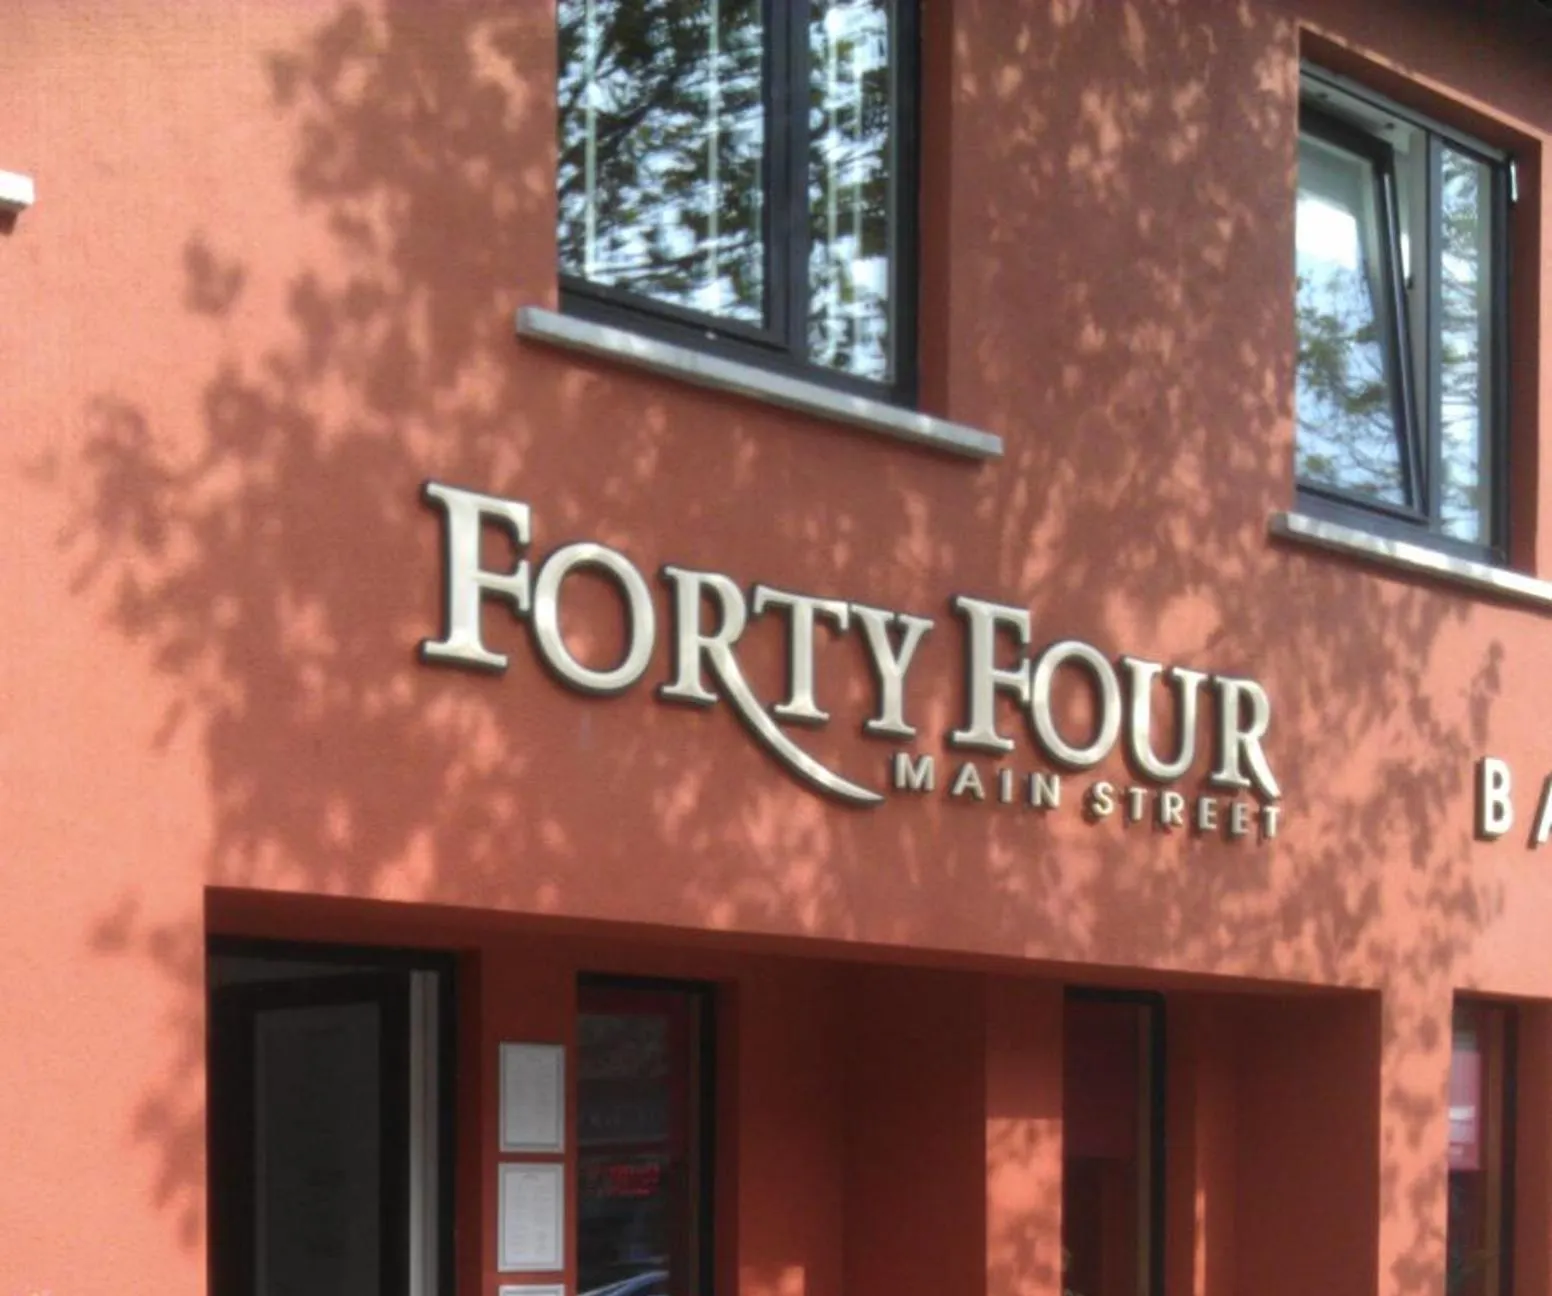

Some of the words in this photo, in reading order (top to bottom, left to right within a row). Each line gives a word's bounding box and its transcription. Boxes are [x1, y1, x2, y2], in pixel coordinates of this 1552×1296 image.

[421, 481, 935, 804] FORTY
[952, 596, 1282, 799] FOUR
[894, 752, 1061, 809] MAIN
[1091, 782, 1281, 840] STREET
